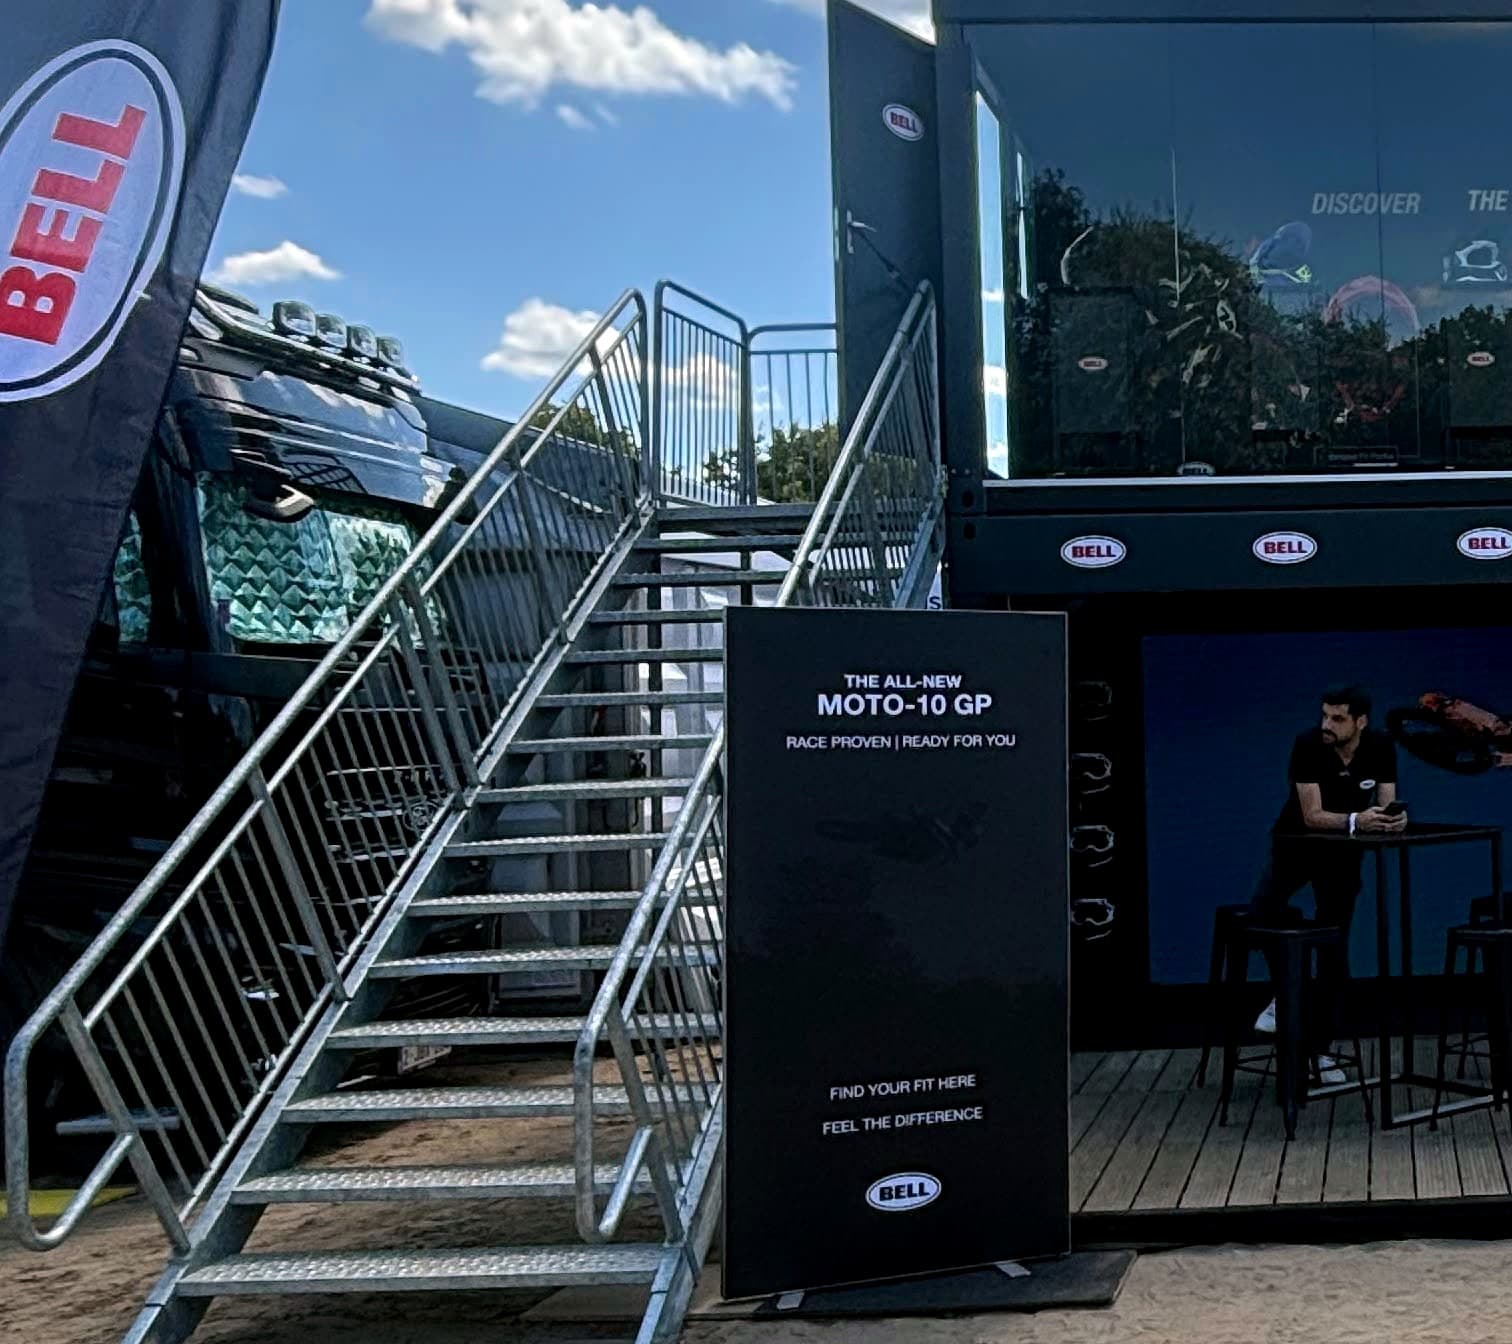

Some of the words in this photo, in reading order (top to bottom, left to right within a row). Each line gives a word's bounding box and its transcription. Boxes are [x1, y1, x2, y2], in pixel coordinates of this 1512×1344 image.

[890, 111, 918, 134] BELL
[1311, 192, 1421, 215] DISCOVER
[1467, 189, 1507, 212] THE
[0, 104, 147, 345] BELL
[1071, 544, 1117, 559] BELL
[1263, 539, 1308, 555] BELL
[1467, 535, 1511, 551] BELL
[844, 674, 880, 689] THE
[883, 674, 962, 689] ALL-NEW
[817, 693, 947, 716] MOTO-10
[953, 693, 993, 716] GP
[786, 736, 828, 750] RACE
[831, 735, 892, 749] PROVEN
[902, 734, 950, 749] READY
[953, 734, 983, 748] FOR
[985, 733, 1016, 747] YOU
[830, 1084, 865, 1102] FIND
[867, 1080, 911, 1098] YOUR
[913, 1077, 936, 1094] FIT
[938, 1074, 976, 1090] HERE
[822, 1117, 860, 1136] FEEL
[862, 1115, 892, 1131] THE
[895, 1106, 984, 1128] DIFFERENCE
[878, 1181, 931, 1202] BELL
